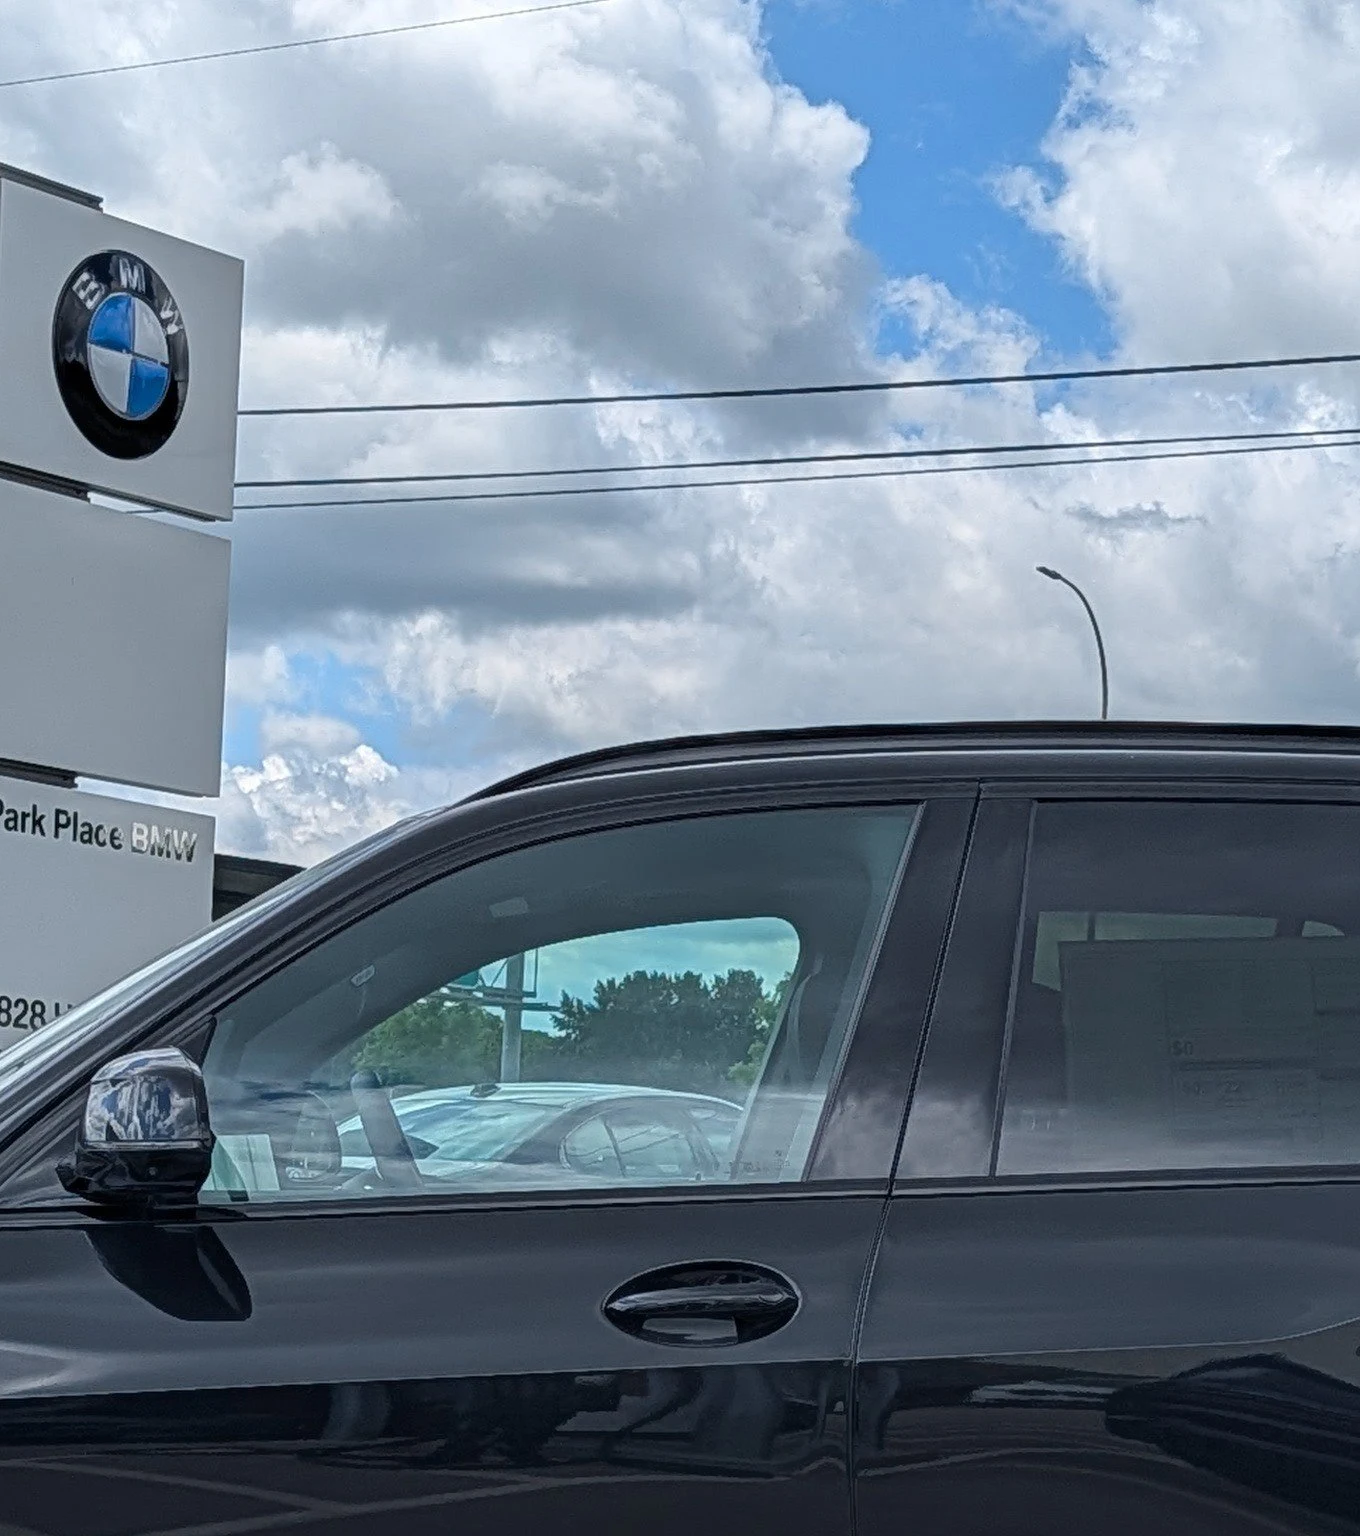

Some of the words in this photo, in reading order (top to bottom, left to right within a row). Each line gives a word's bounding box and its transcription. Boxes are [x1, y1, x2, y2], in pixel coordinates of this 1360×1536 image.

[72, 257, 183, 335] BMW
[54, 808, 123, 850] Place
[131, 822, 197, 862] BMW
